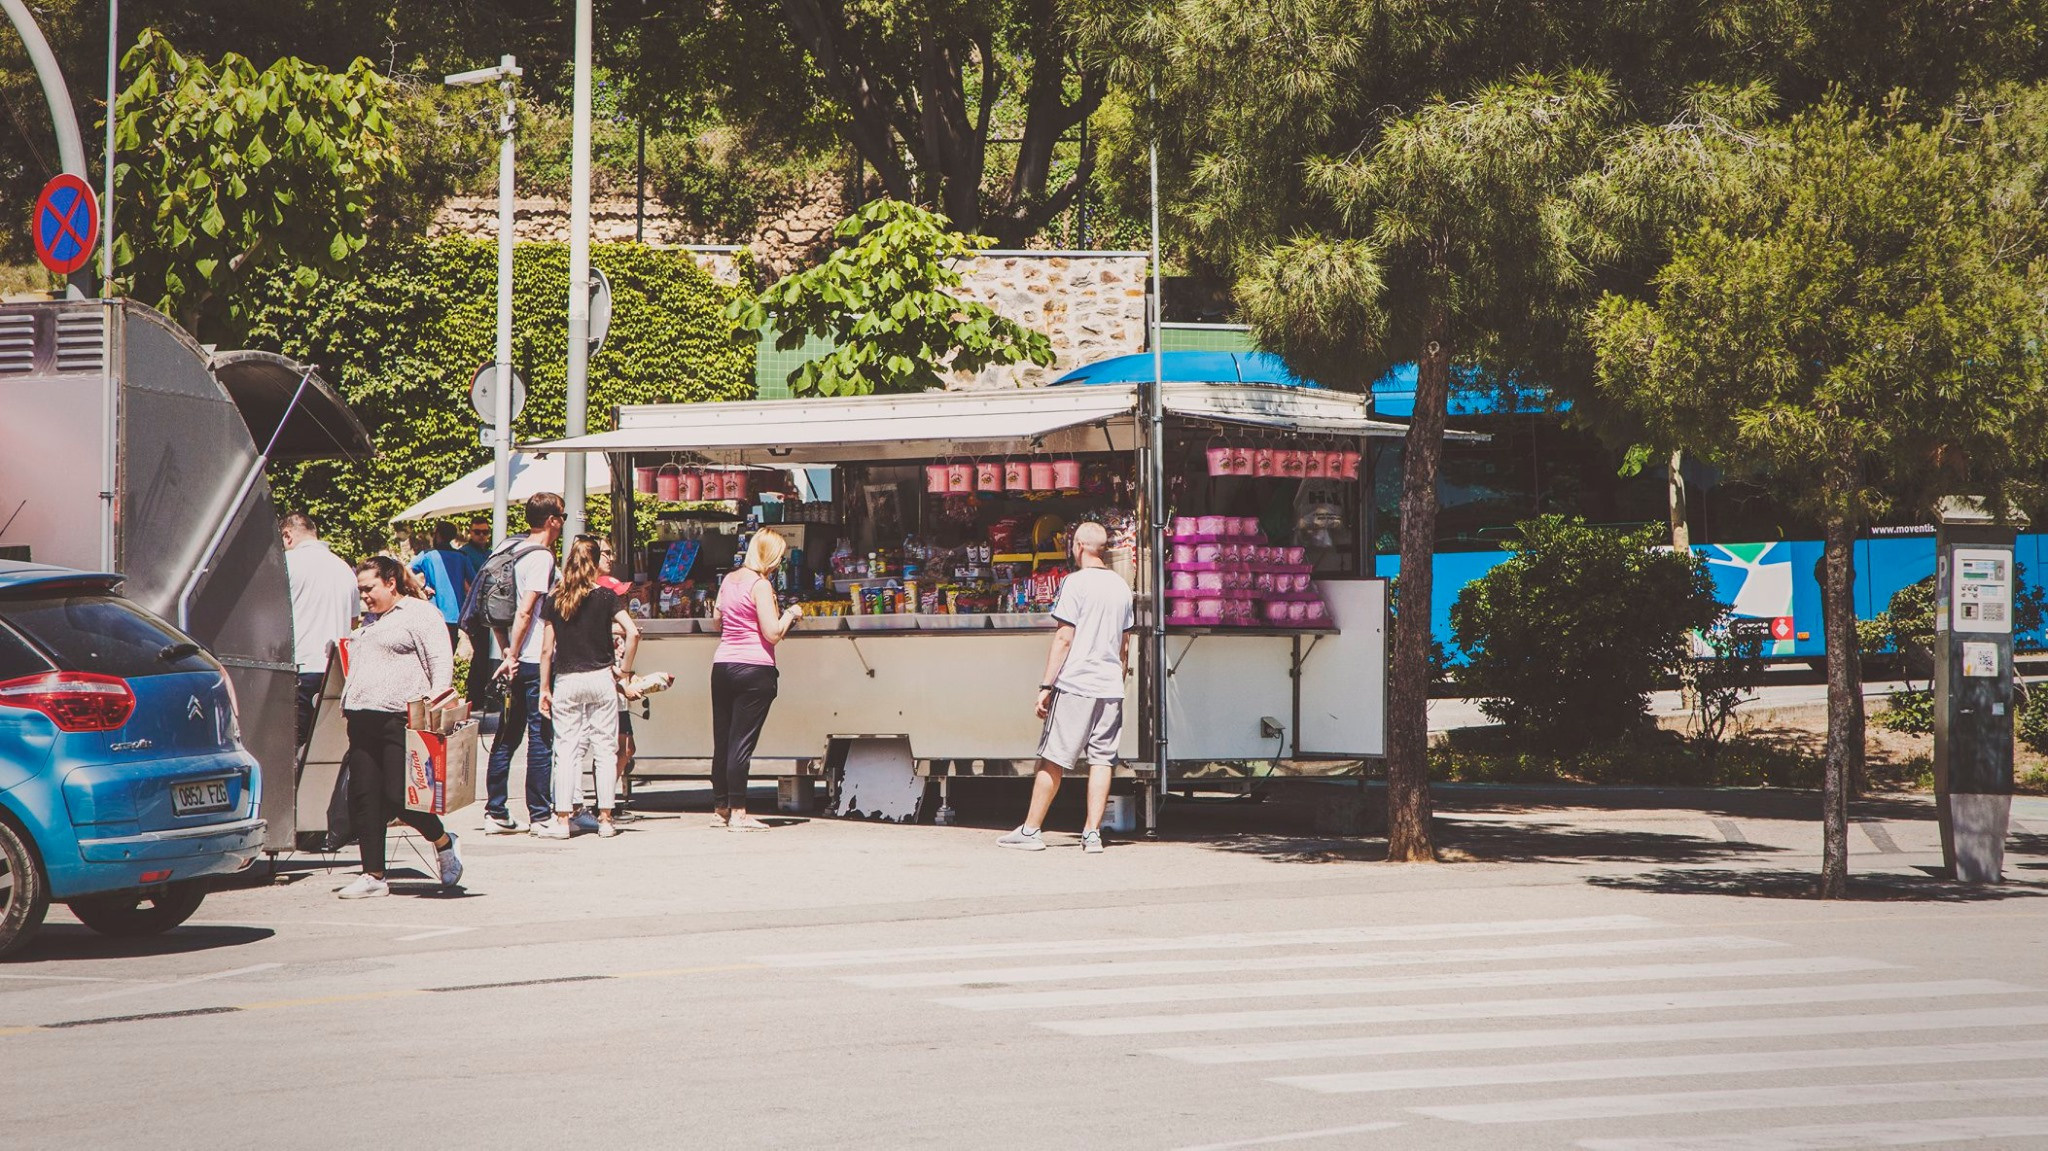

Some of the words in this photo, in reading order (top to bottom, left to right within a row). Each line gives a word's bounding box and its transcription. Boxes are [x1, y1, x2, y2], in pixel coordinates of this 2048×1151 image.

[1938, 555, 1948, 590] P
[179, 785, 205, 806] 0852
[206, 783, 228, 804] FZG
